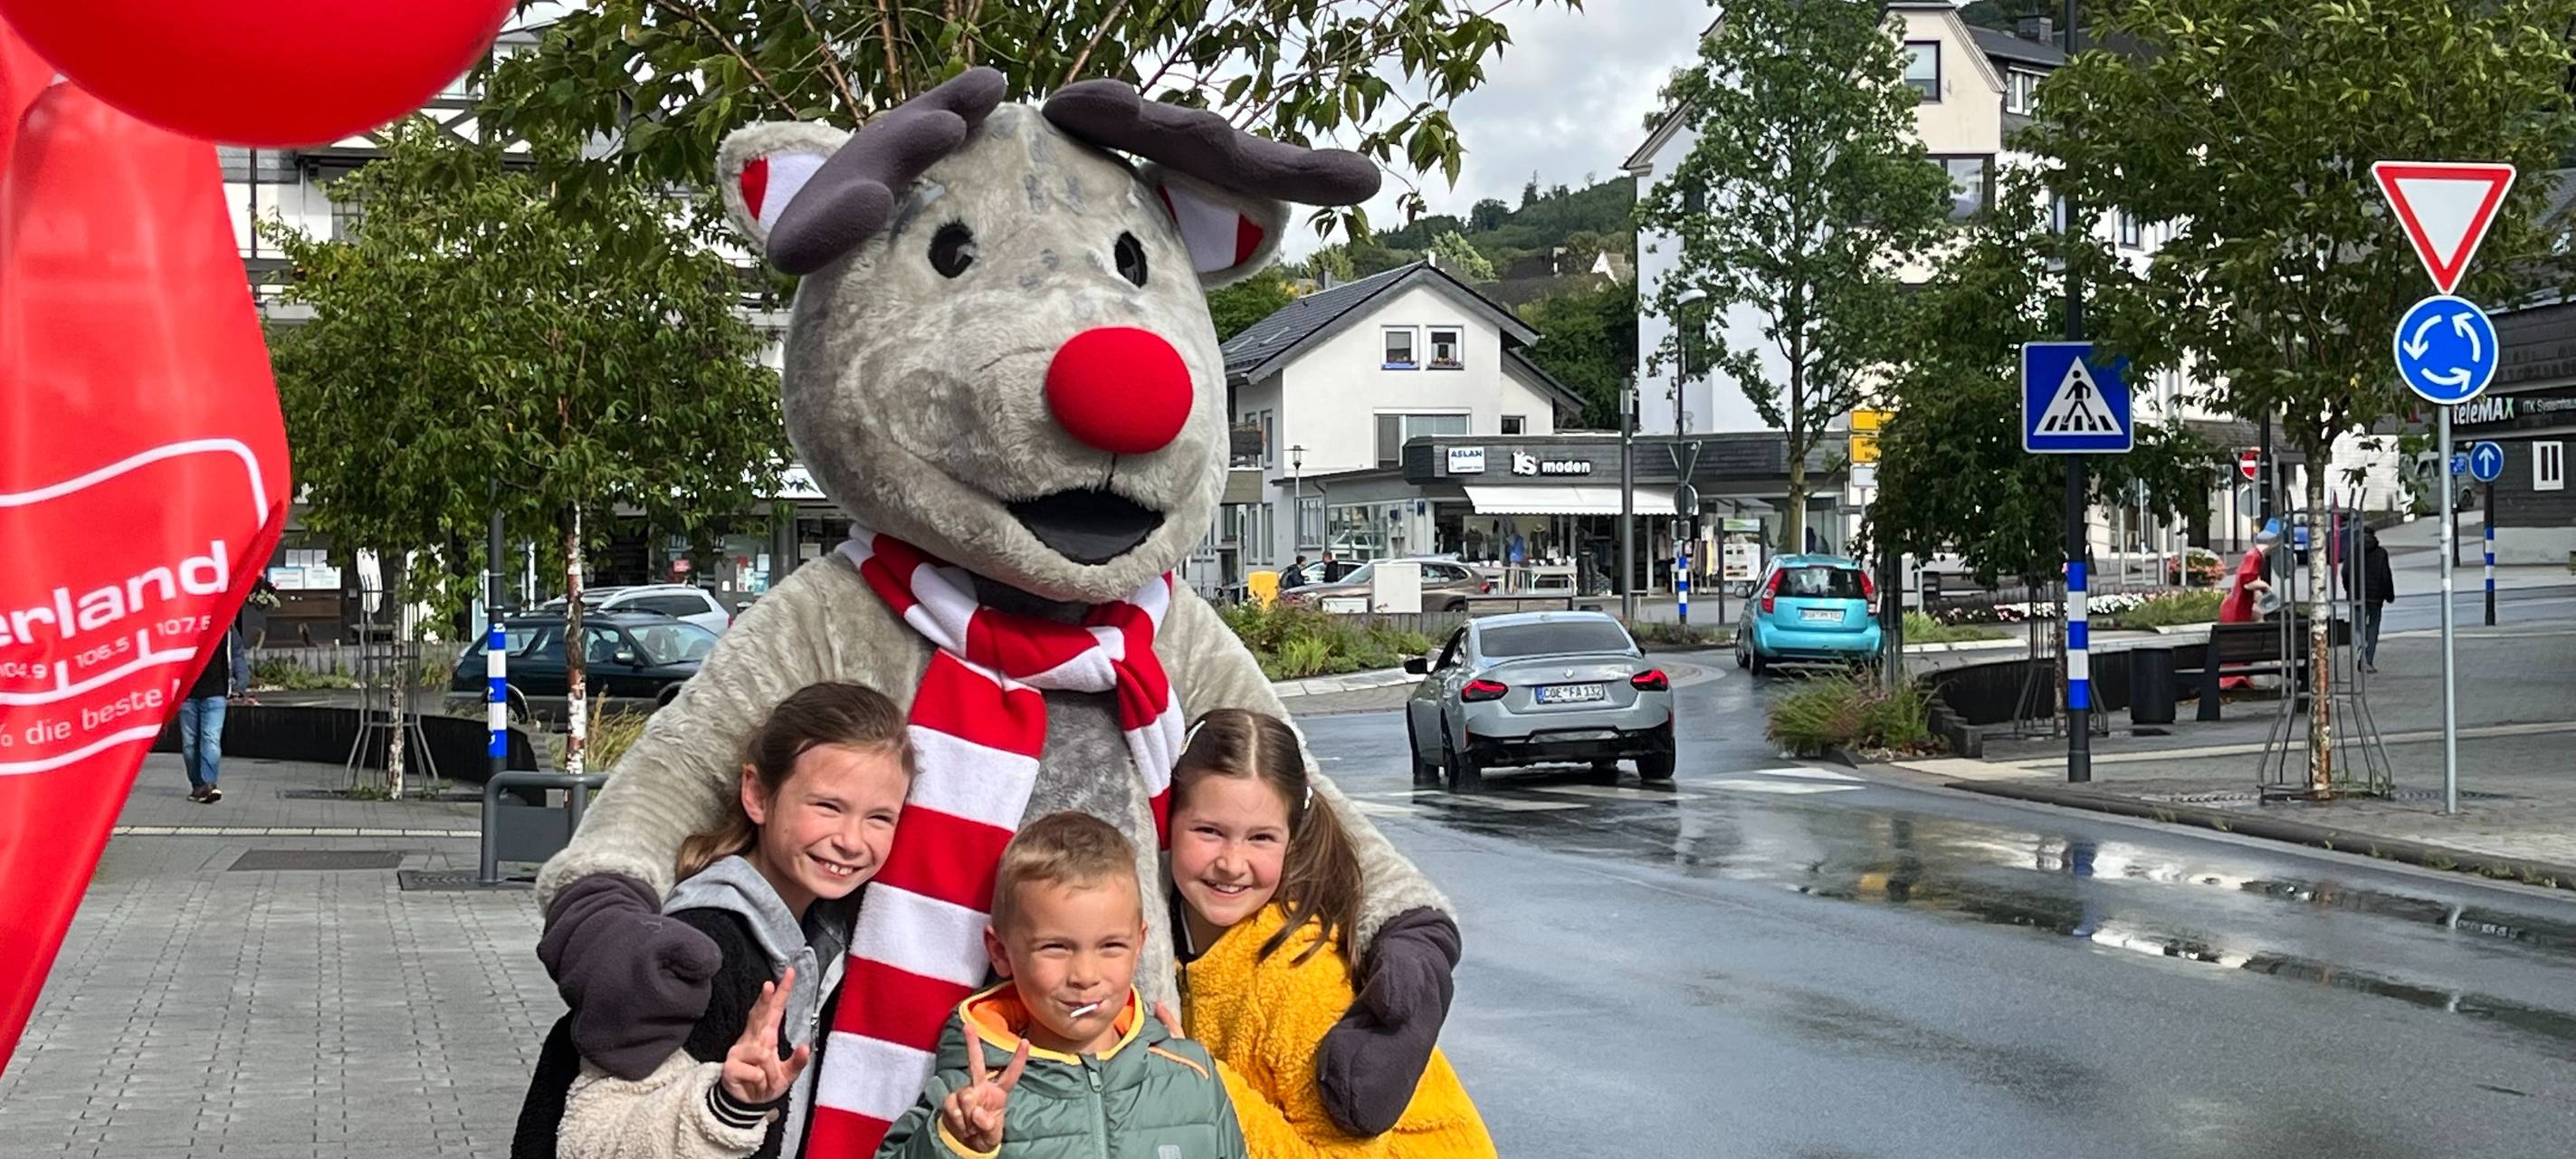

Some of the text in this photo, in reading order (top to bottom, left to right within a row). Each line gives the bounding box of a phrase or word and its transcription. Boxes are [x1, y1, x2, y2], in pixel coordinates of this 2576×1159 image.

[2454, 397, 2514, 425] teleMAX
[1542, 461, 1590, 473] moden
[25, 719, 72, 746] die
[81, 688, 163, 731] beste
